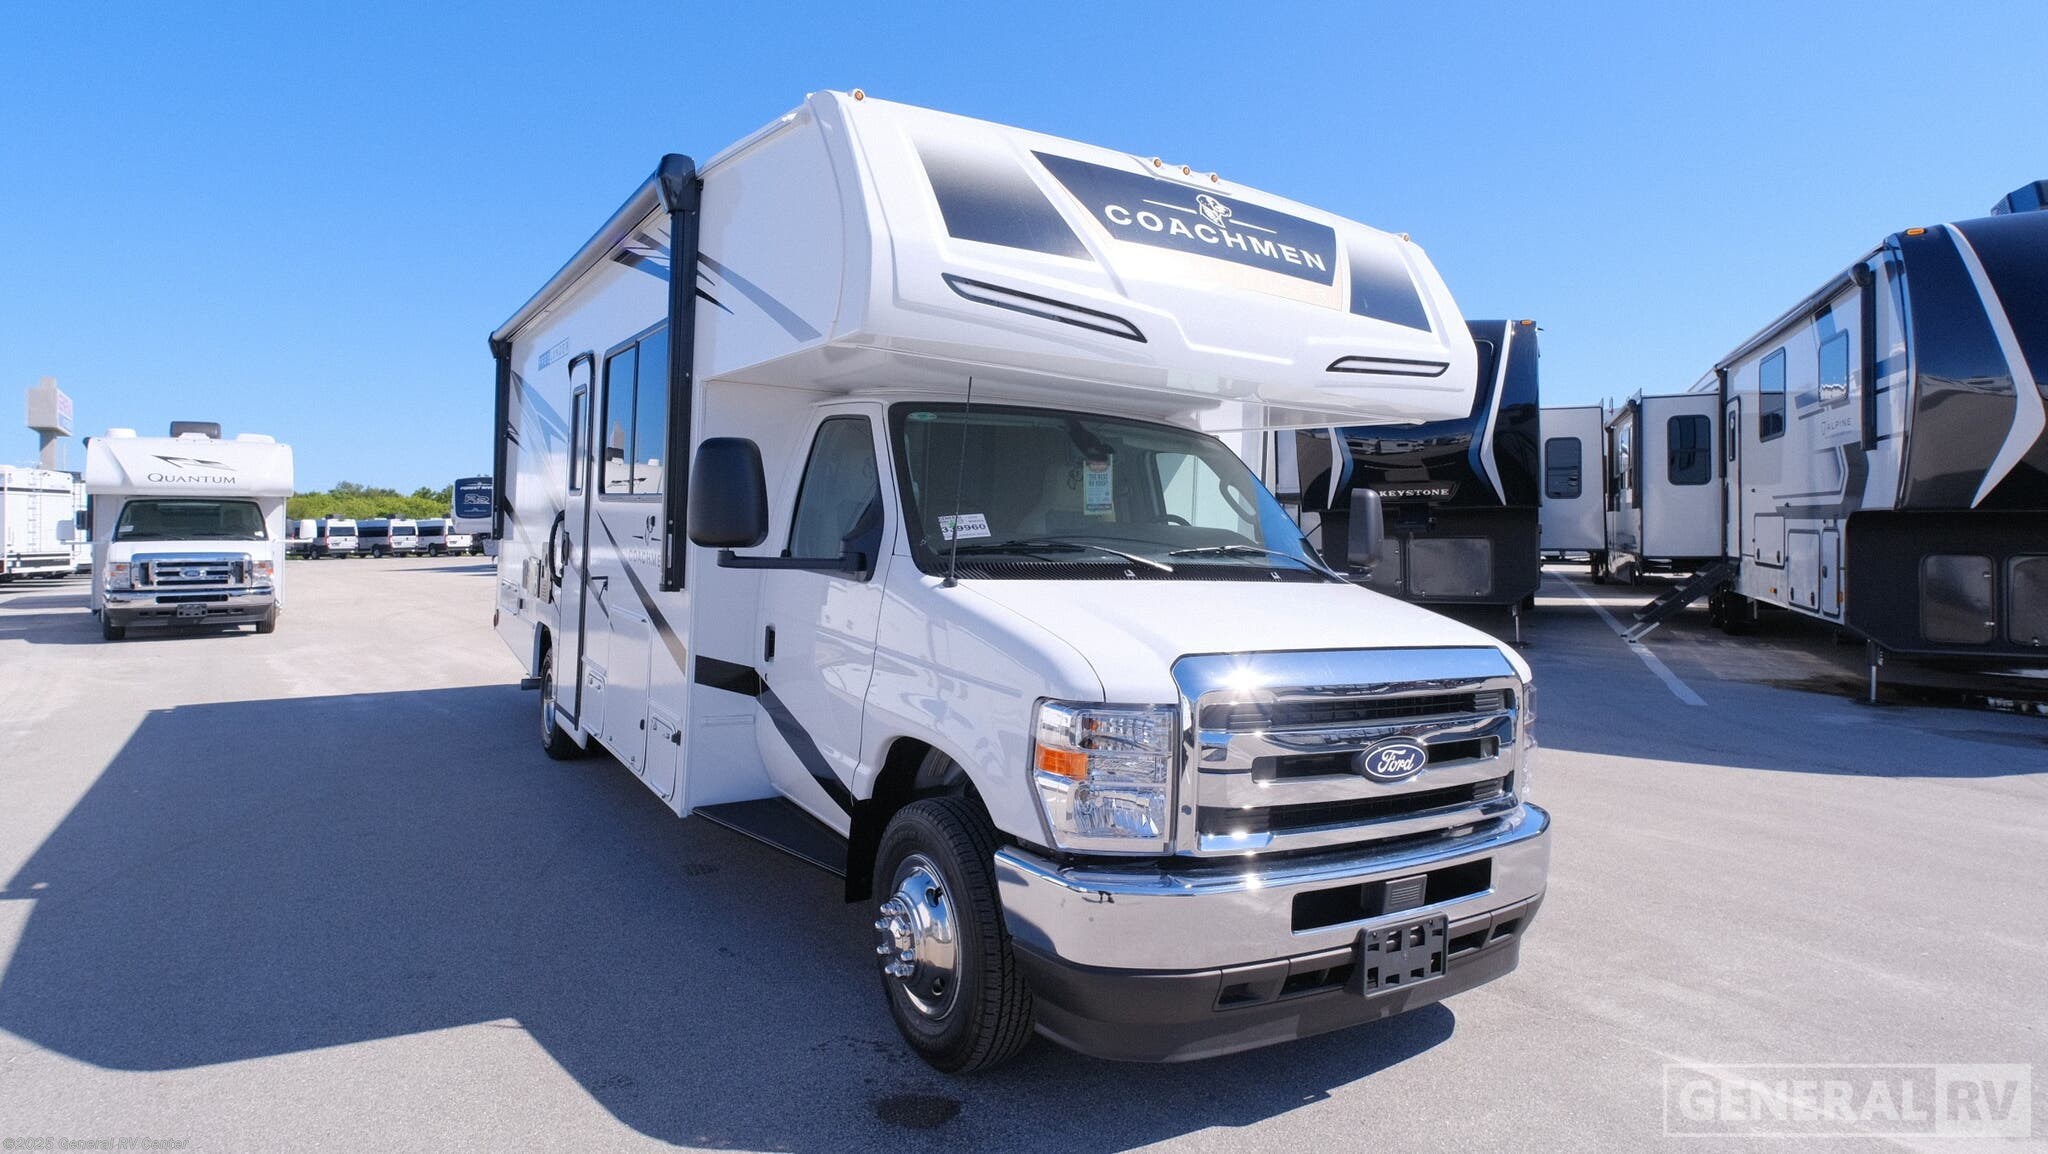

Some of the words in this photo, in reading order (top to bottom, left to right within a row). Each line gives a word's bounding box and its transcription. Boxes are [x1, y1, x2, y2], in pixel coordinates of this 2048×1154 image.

[1104, 204, 1327, 272] COACHMEN
[1826, 417, 1854, 430] ALPINE
[147, 472, 236, 485] QUANTUM
[1379, 488, 1450, 497] KEYSTONE
[628, 548, 661, 568] COACHME
[1377, 749, 1416, 773] Ford
